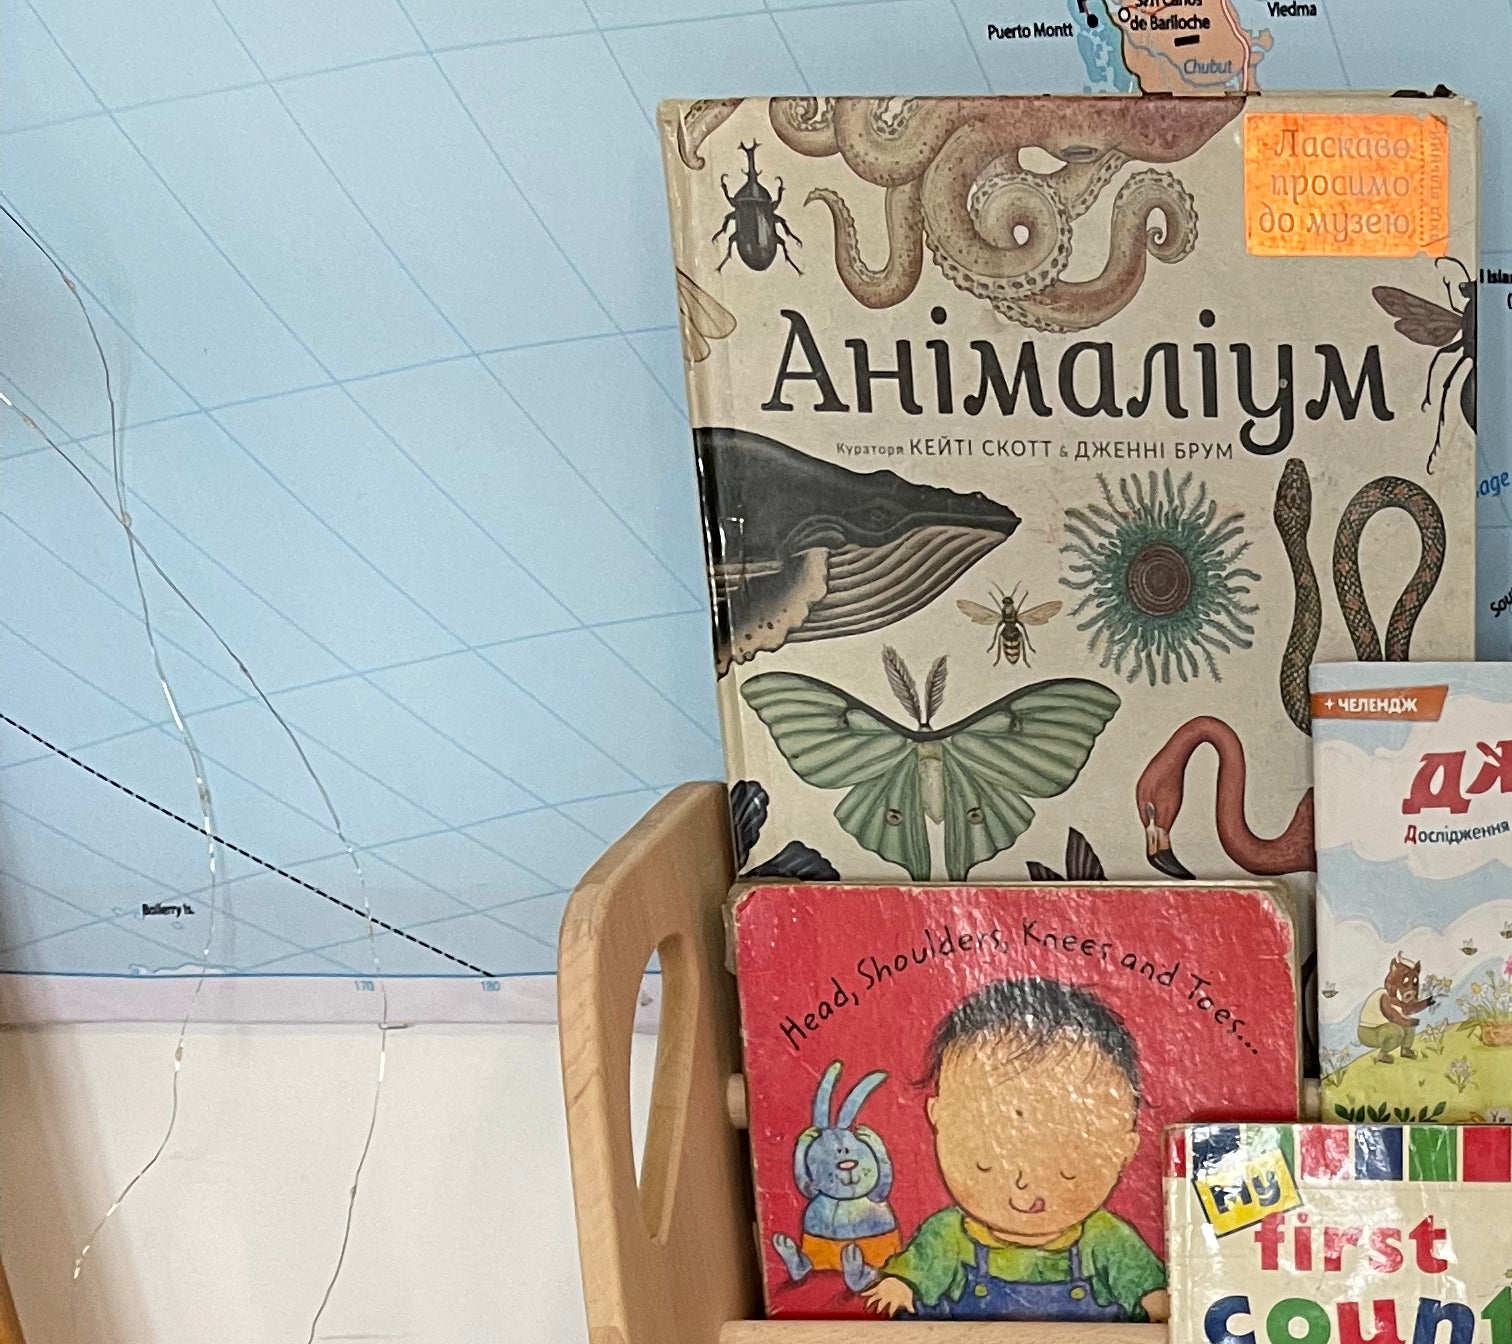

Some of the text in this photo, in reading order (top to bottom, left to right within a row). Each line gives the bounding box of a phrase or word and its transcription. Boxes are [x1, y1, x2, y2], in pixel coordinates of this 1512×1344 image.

[987, 22, 1073, 40] Puerto Montt
[1130, 15, 1211, 30] de Bariloche
[1273, 128, 1411, 160] Ласкаво
[1270, 172, 1411, 205] просимо
[1258, 201, 1411, 243] до музею
[760, 305, 1395, 455] Анімаліум
[909, 436, 973, 458] КЕЙТІ
[981, 439, 1053, 458] СКОТТ
[1074, 441, 1165, 461] ДЖЕННІ
[1174, 442, 1233, 460] БРУМ
[1476, 471, 1511, 497] age
[1337, 697, 1418, 714] ЧЕЛЕНДЖ
[779, 976, 859, 1052] Head,
[857, 924, 1009, 991] Shoulders,
[1022, 917, 1113, 960] Knees
[1120, 952, 1181, 987] and
[1253, 1210, 1449, 1275] first
